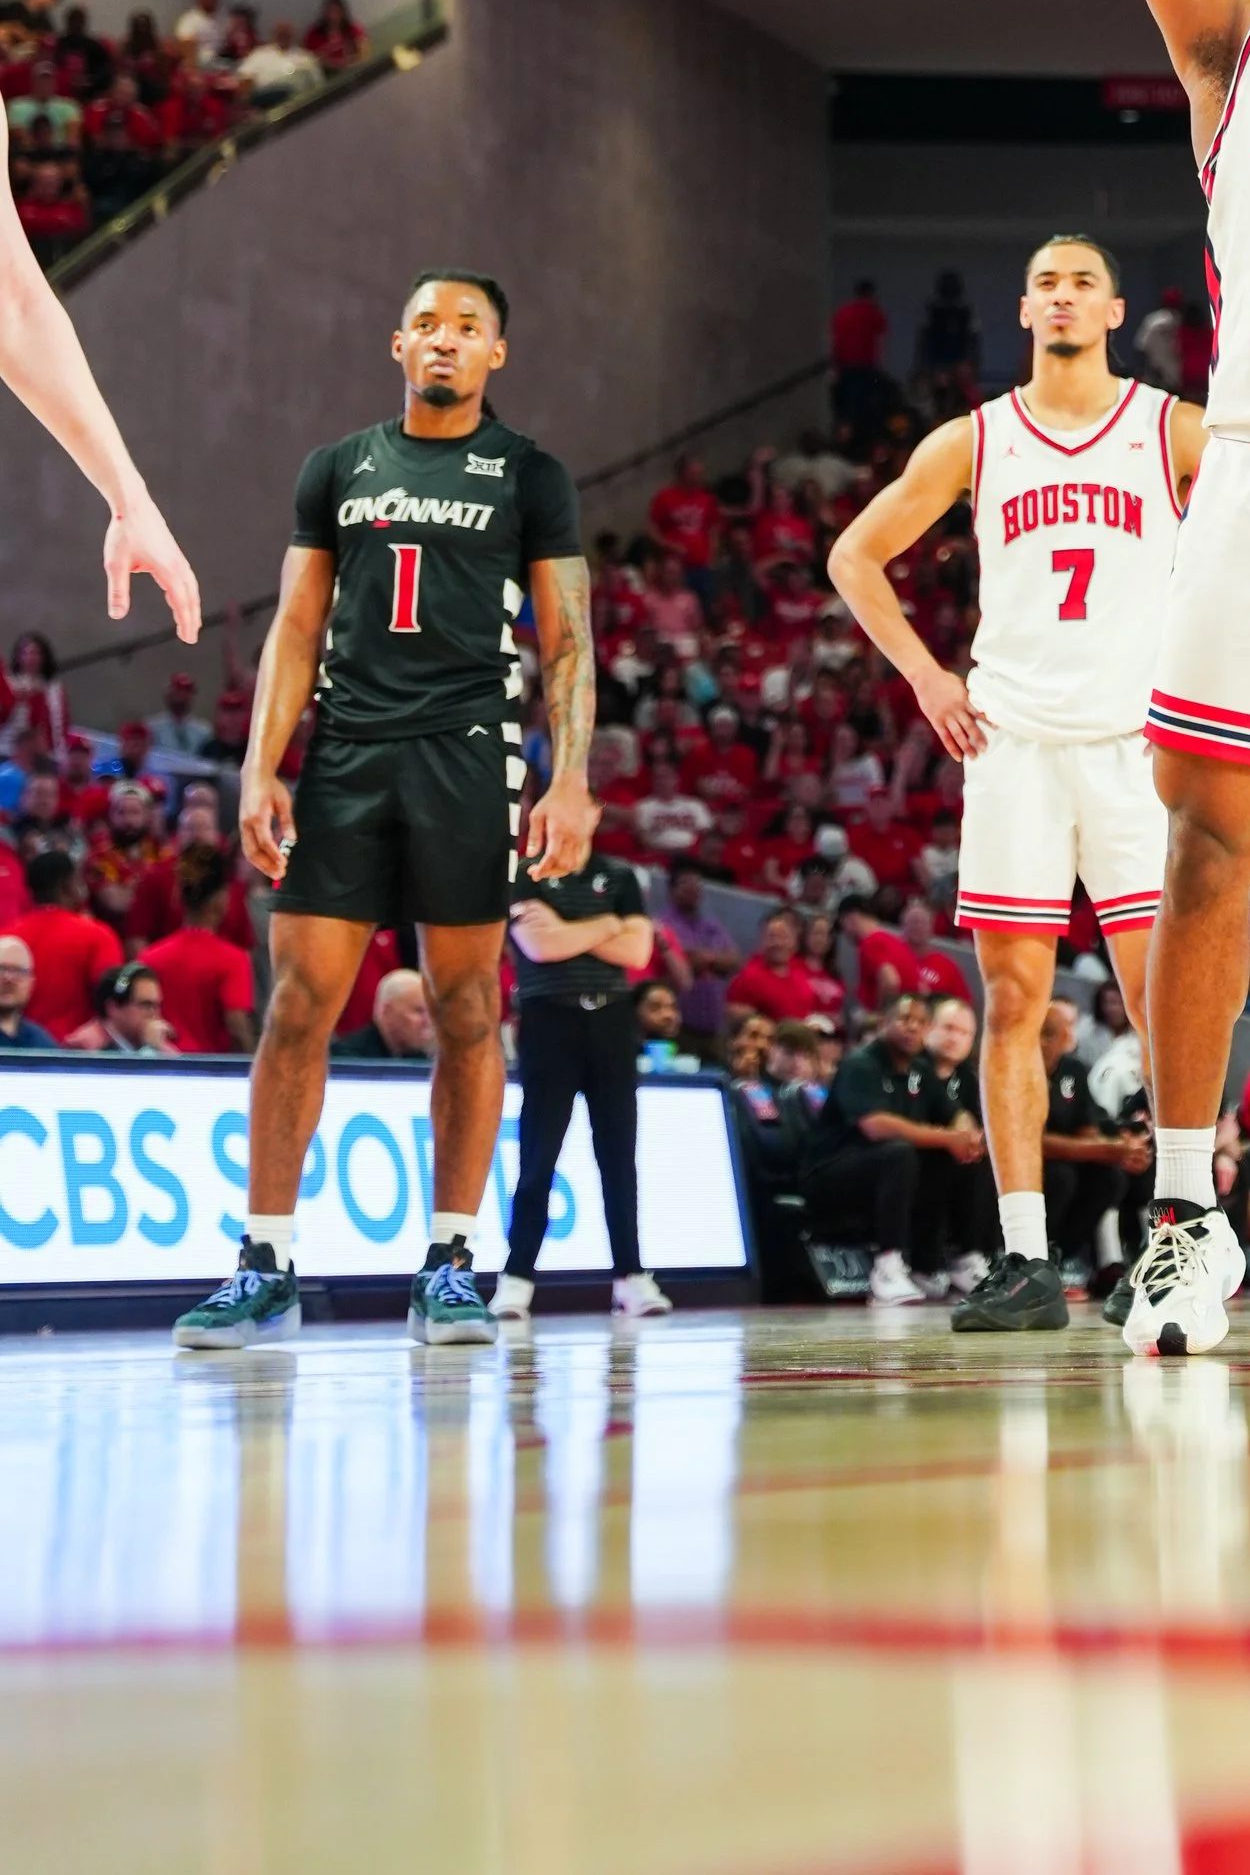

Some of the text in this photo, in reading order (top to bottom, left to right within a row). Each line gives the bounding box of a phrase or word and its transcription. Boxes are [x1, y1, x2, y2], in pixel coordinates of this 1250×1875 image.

[338, 488, 495, 531] CINCINNATI
[1002, 483, 1143, 547] HOUSTON
[387, 543, 423, 634] 1
[1052, 548, 1095, 621] 7
[0, 1106, 189, 1249] CBS
